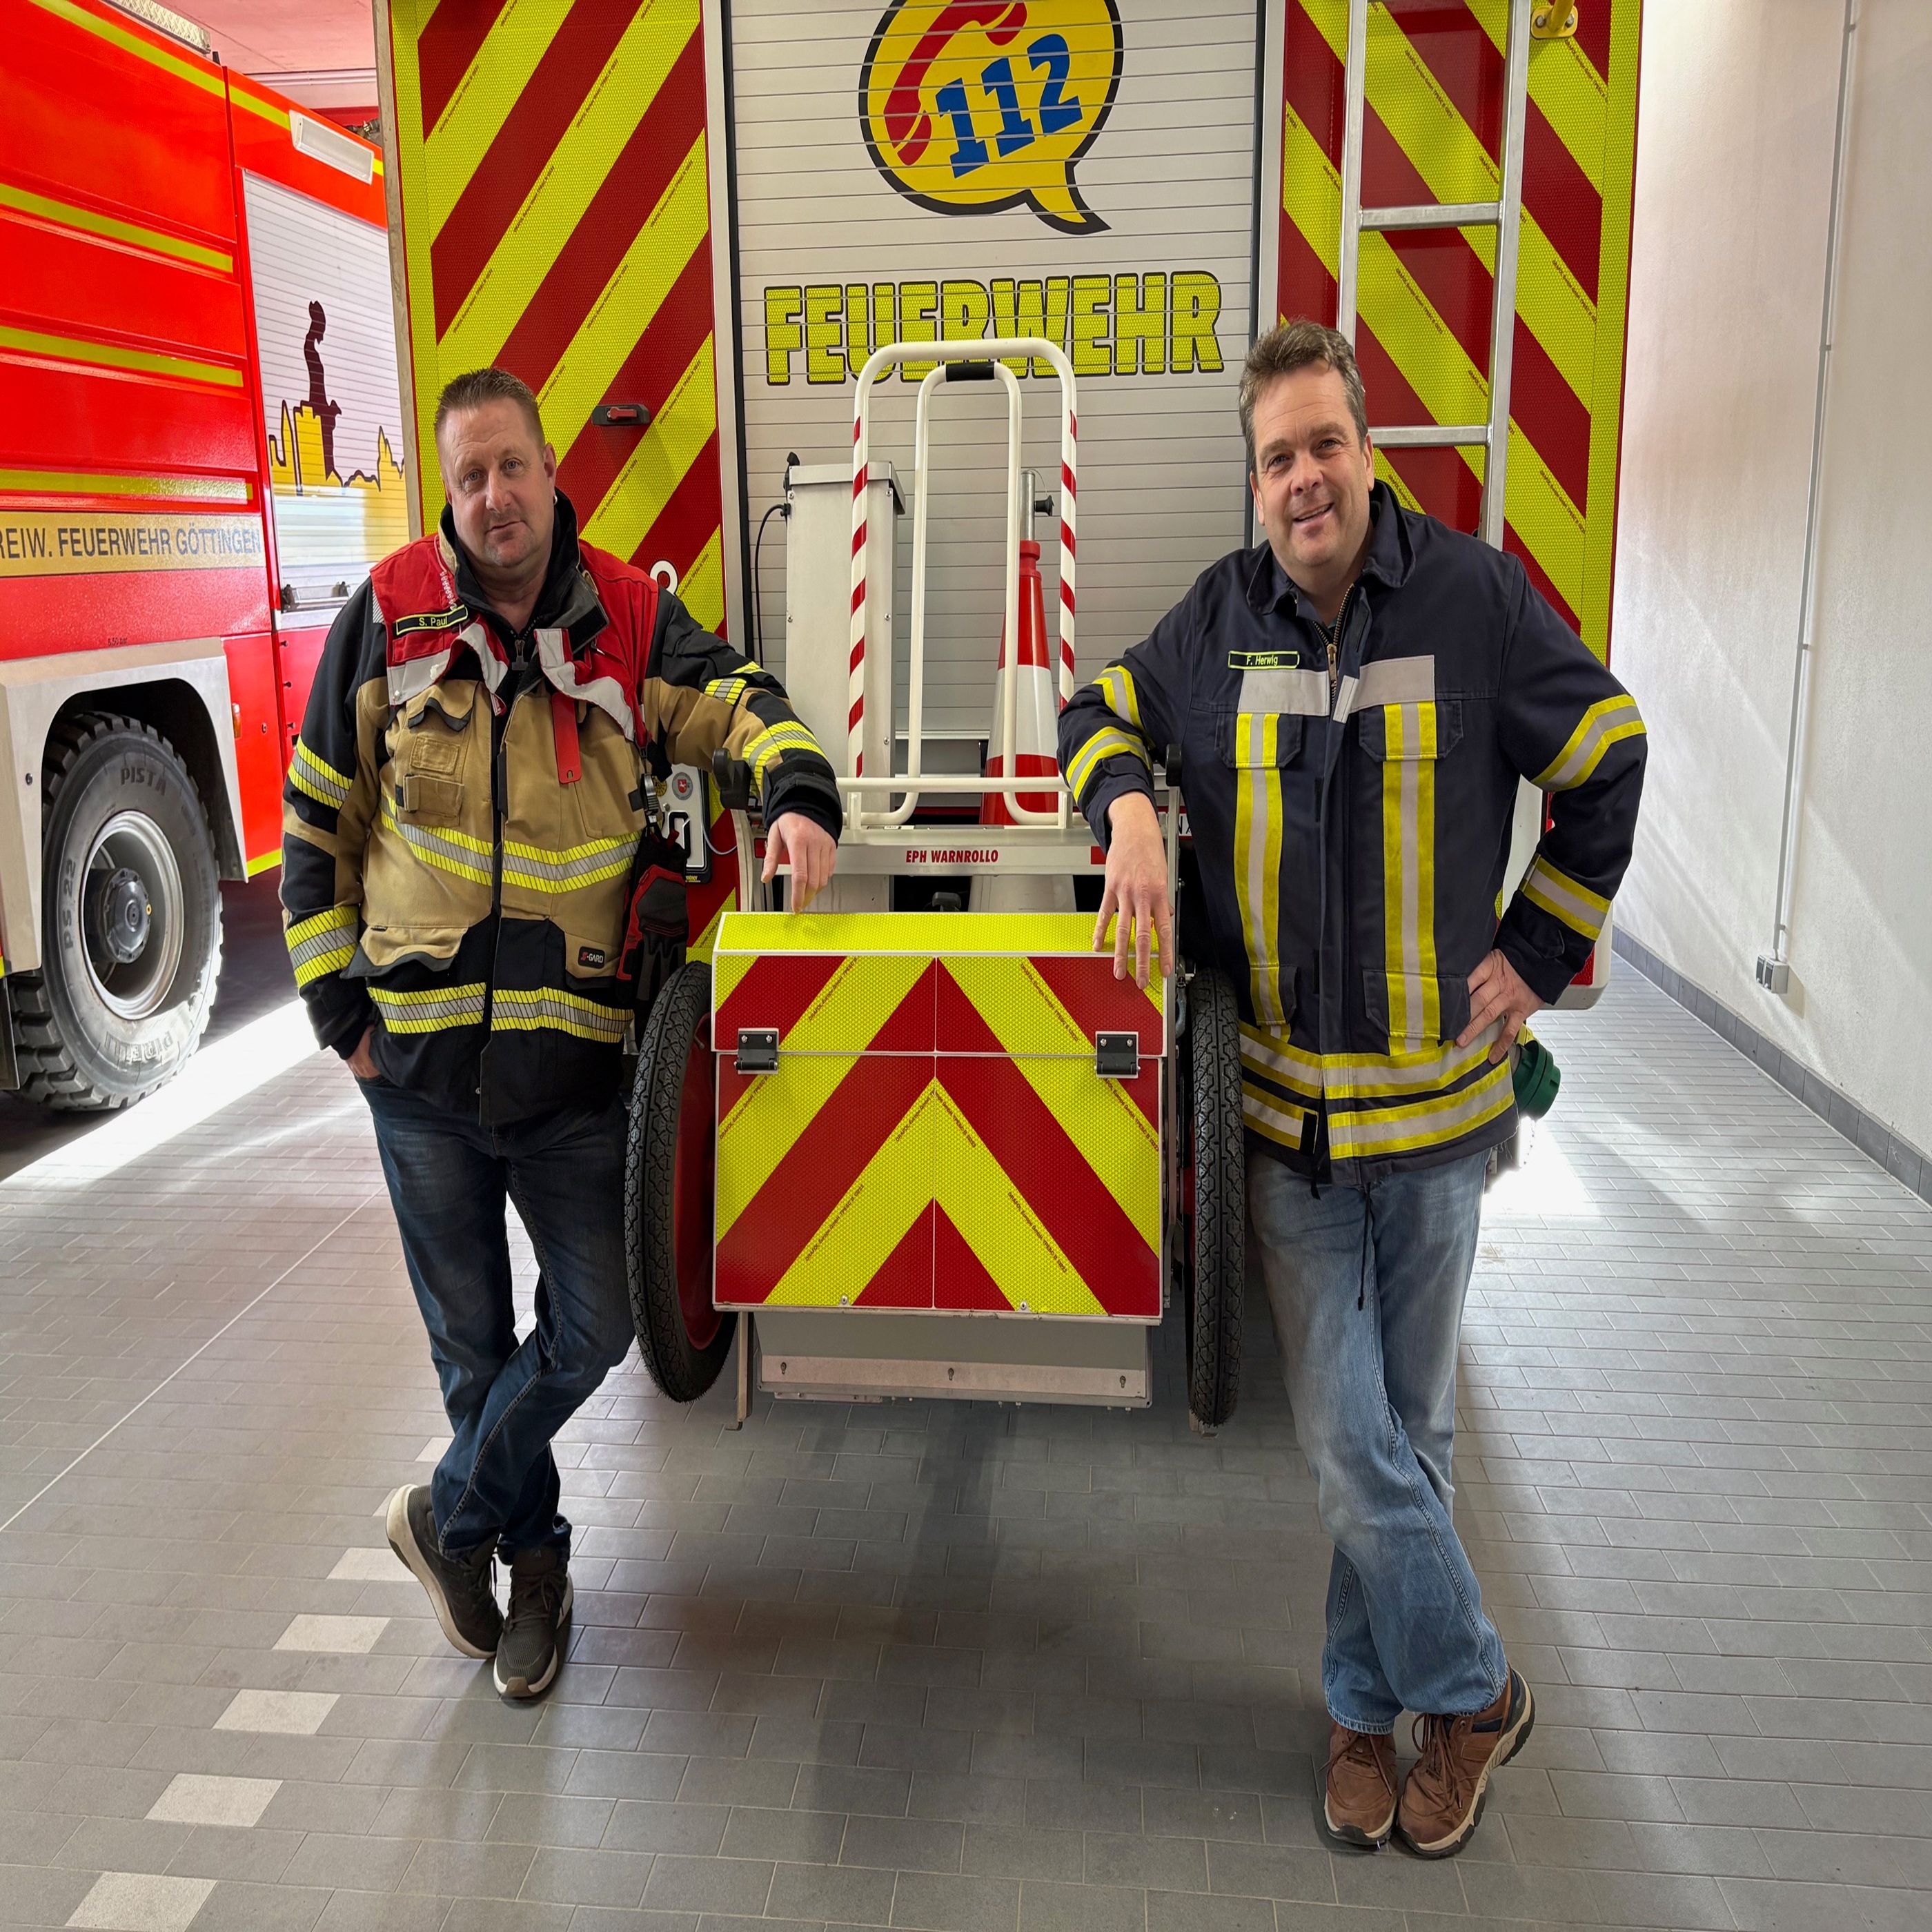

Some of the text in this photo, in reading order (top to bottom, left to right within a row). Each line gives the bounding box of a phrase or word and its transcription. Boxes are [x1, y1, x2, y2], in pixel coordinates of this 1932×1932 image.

[936, 34, 1083, 178] 112
[764, 270, 1224, 386] FEUERWEHR
[58, 526, 172, 557] FEUERWEHR
[176, 522, 262, 554] GÖTTINGEN
[419, 616, 447, 626] S. Paul
[1246, 656, 1253, 665] F.
[121, 767, 167, 796] PISTA
[906, 849, 998, 863] EPH WARNROLLO
